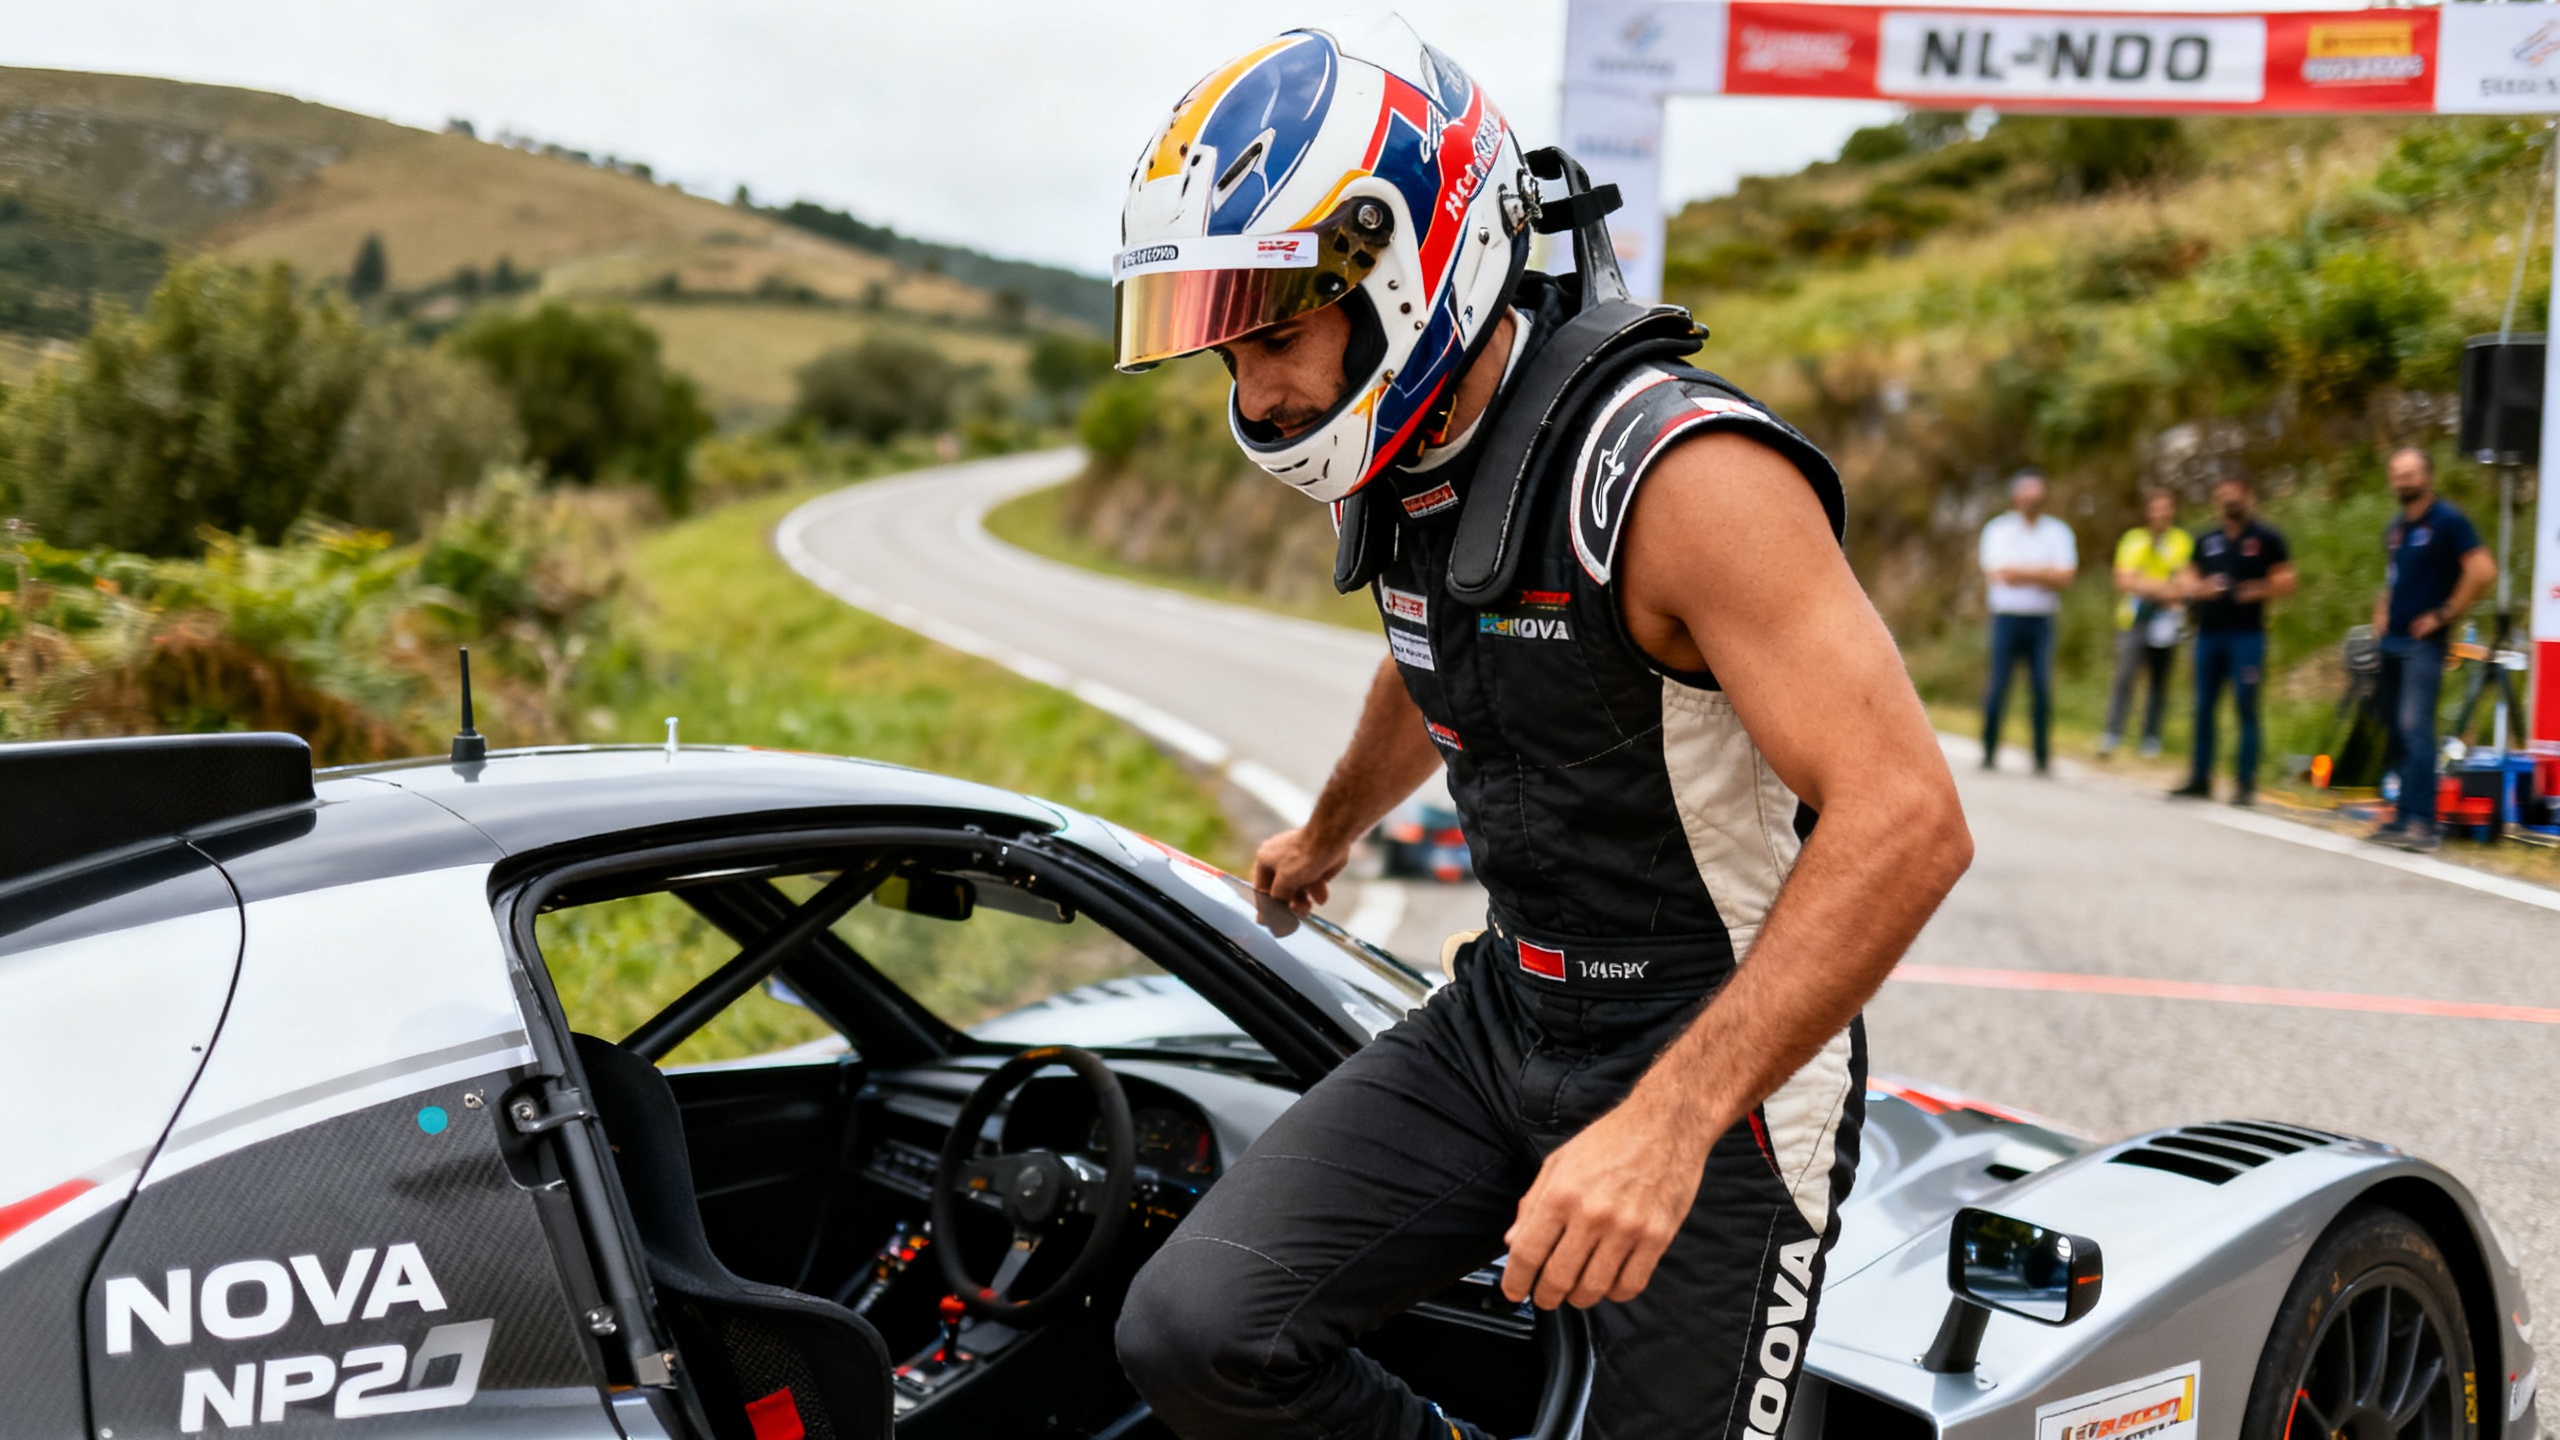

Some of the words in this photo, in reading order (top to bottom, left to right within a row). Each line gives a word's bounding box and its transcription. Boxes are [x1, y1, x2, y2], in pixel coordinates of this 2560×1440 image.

[105, 1242, 448, 1355] NOVA
[1742, 1237, 1821, 1440] OOVA
[180, 1318, 495, 1433] NP20
